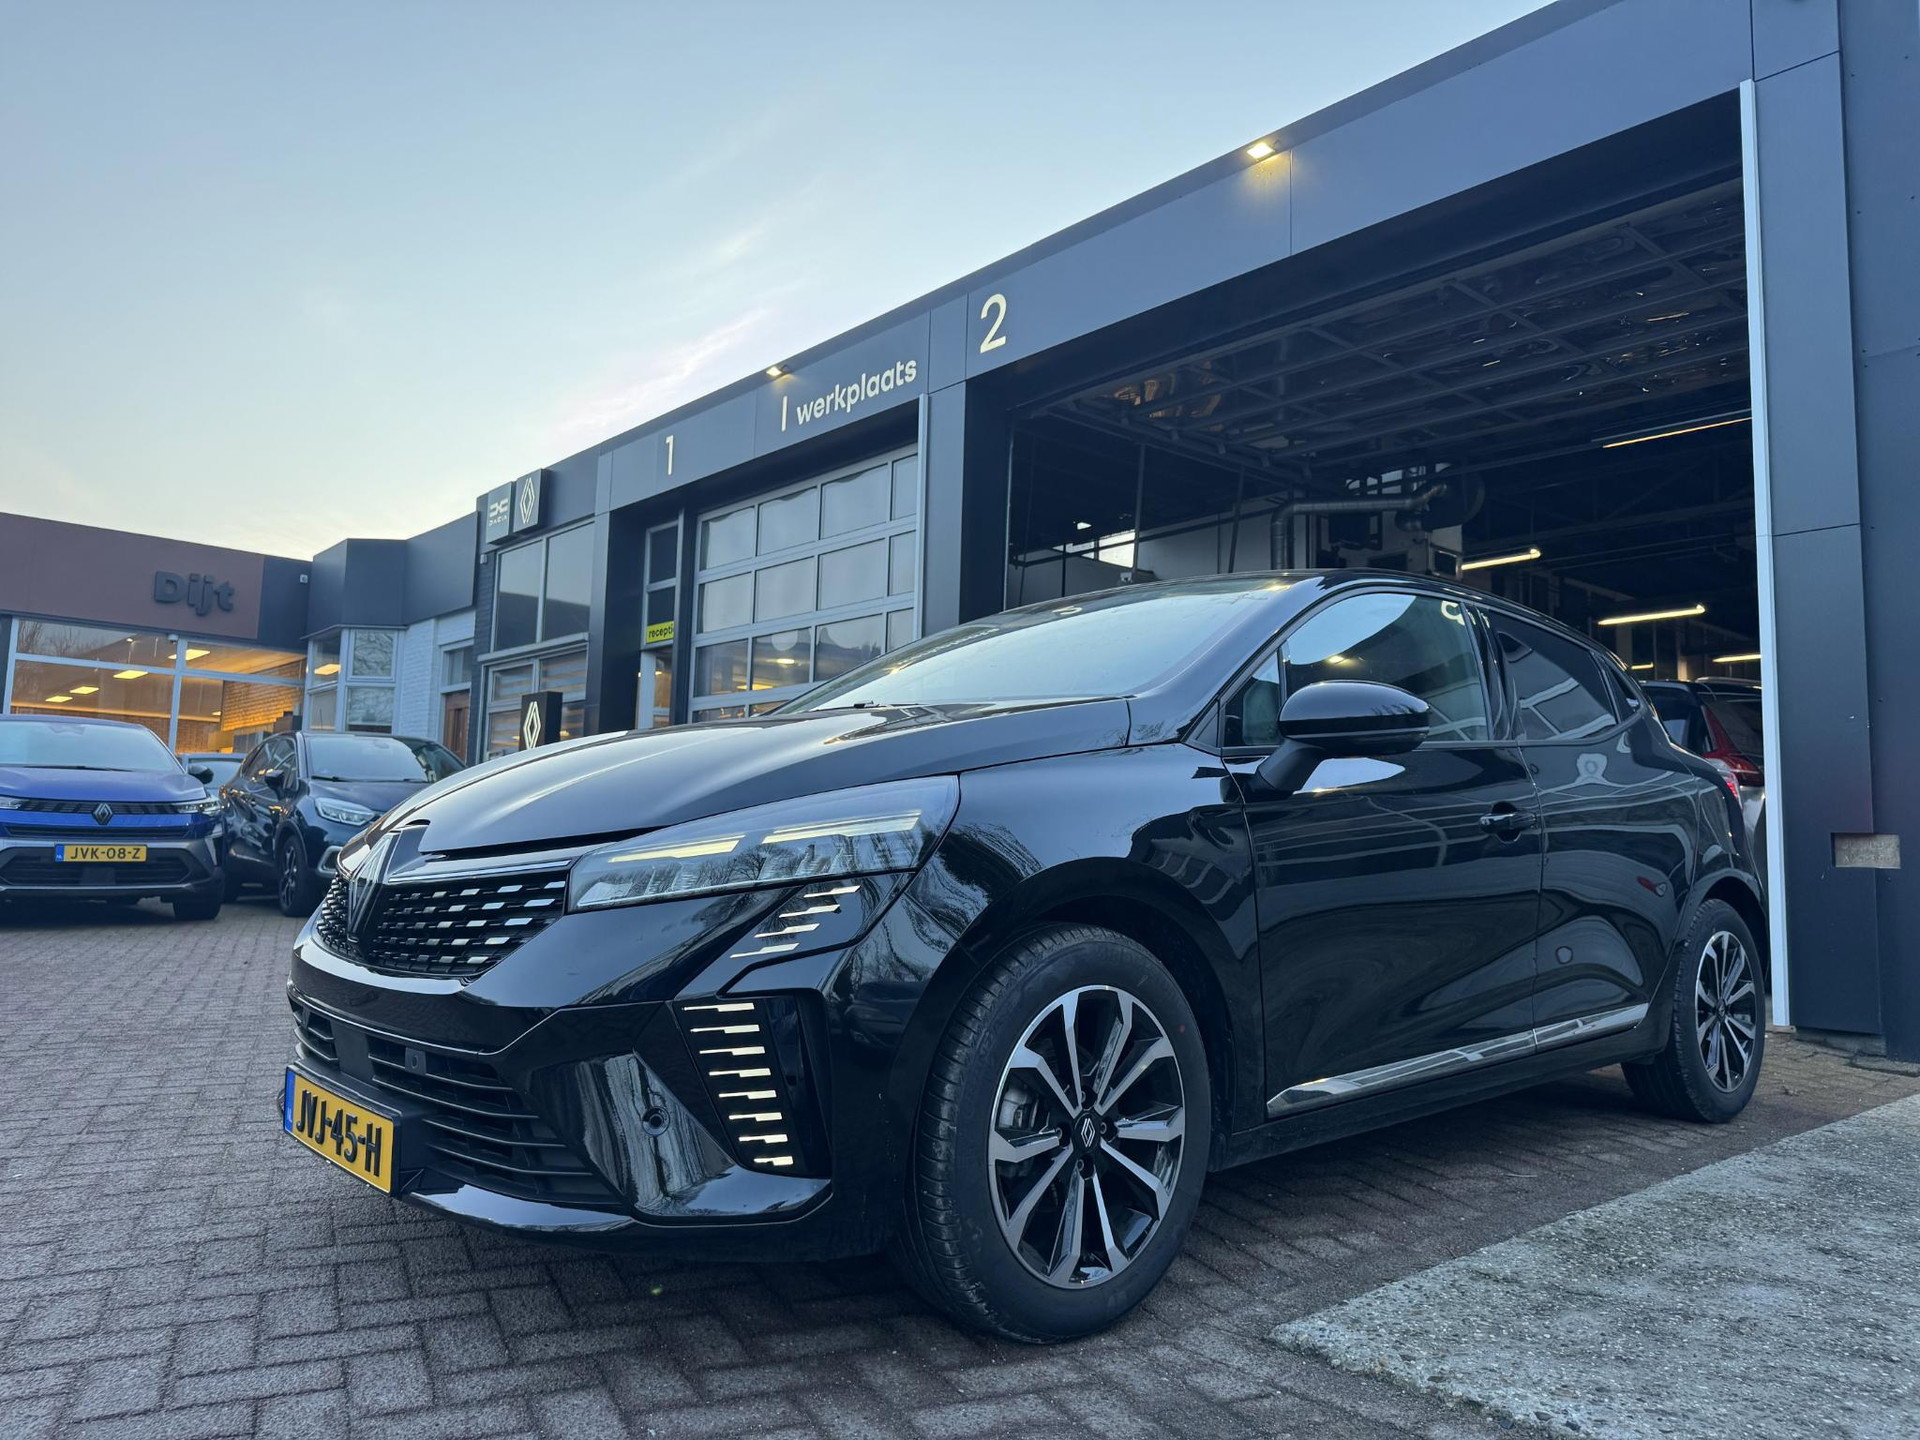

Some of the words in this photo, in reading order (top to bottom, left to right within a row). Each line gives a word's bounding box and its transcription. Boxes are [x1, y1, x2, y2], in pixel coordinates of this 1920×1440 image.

[980, 293, 1007, 354] 2
[796, 359, 917, 426] werkplaats
[665, 434, 674, 476] 1
[154, 570, 235, 617] Dijt
[70, 847, 141, 860] JVK-08-Z
[296, 1089, 382, 1178] JVJ-45-H
